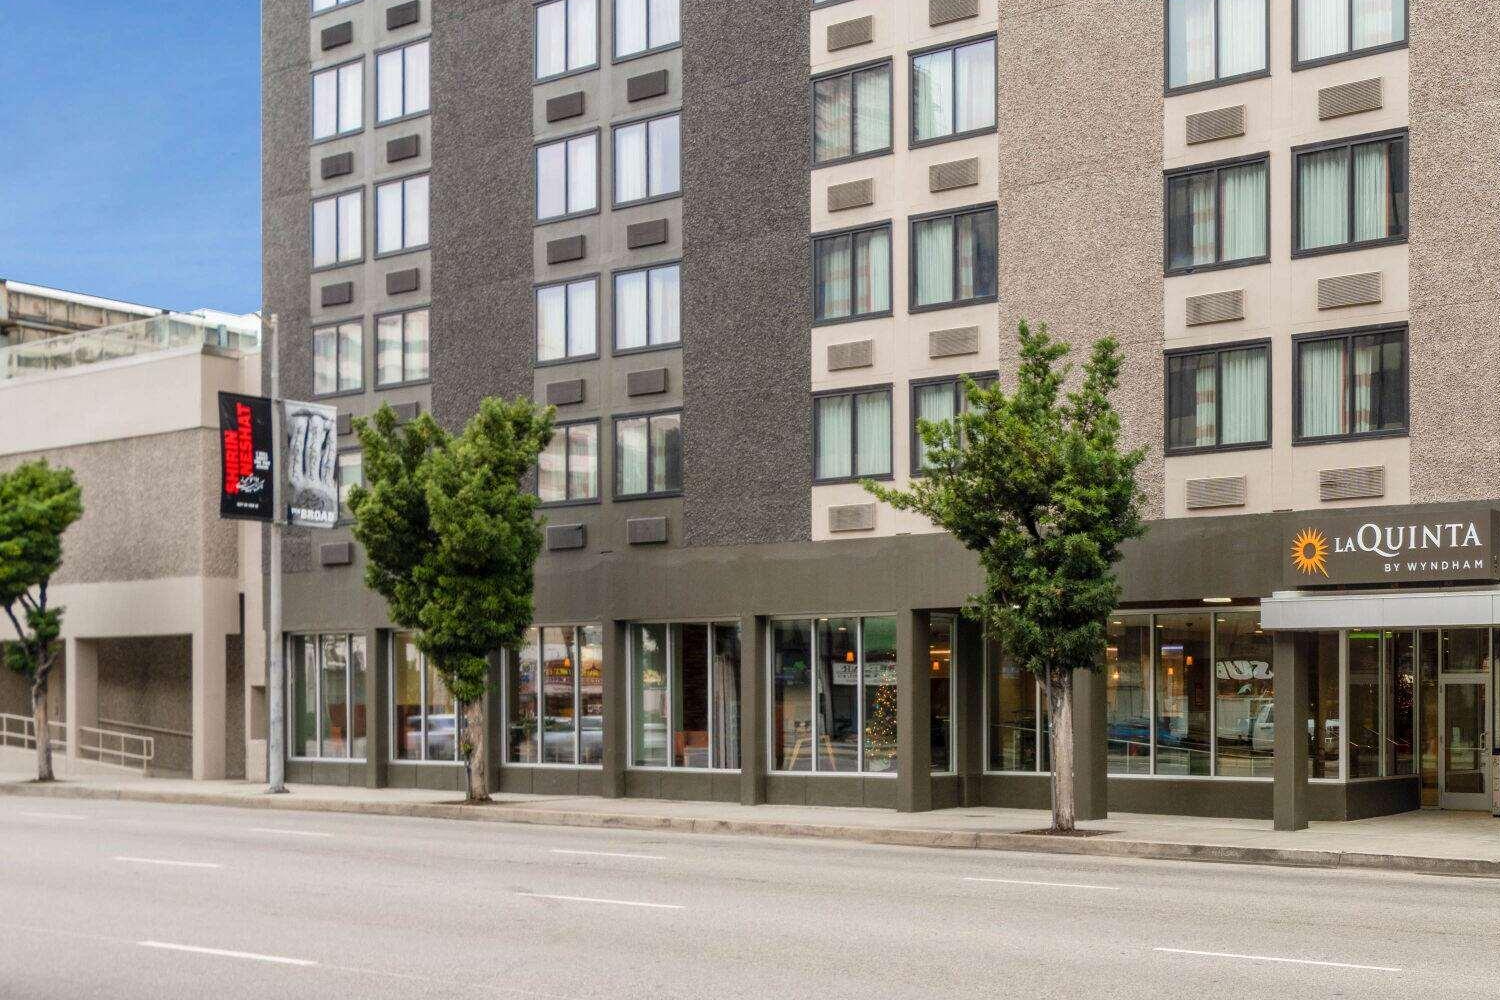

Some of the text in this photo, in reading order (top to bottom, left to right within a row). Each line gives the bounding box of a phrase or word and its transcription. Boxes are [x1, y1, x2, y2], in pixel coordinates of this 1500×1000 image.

[224, 430, 239, 496] SHIRIN
[300, 508, 335, 522] BROAD
[1384, 559, 1484, 573] BY WYNDHAM
